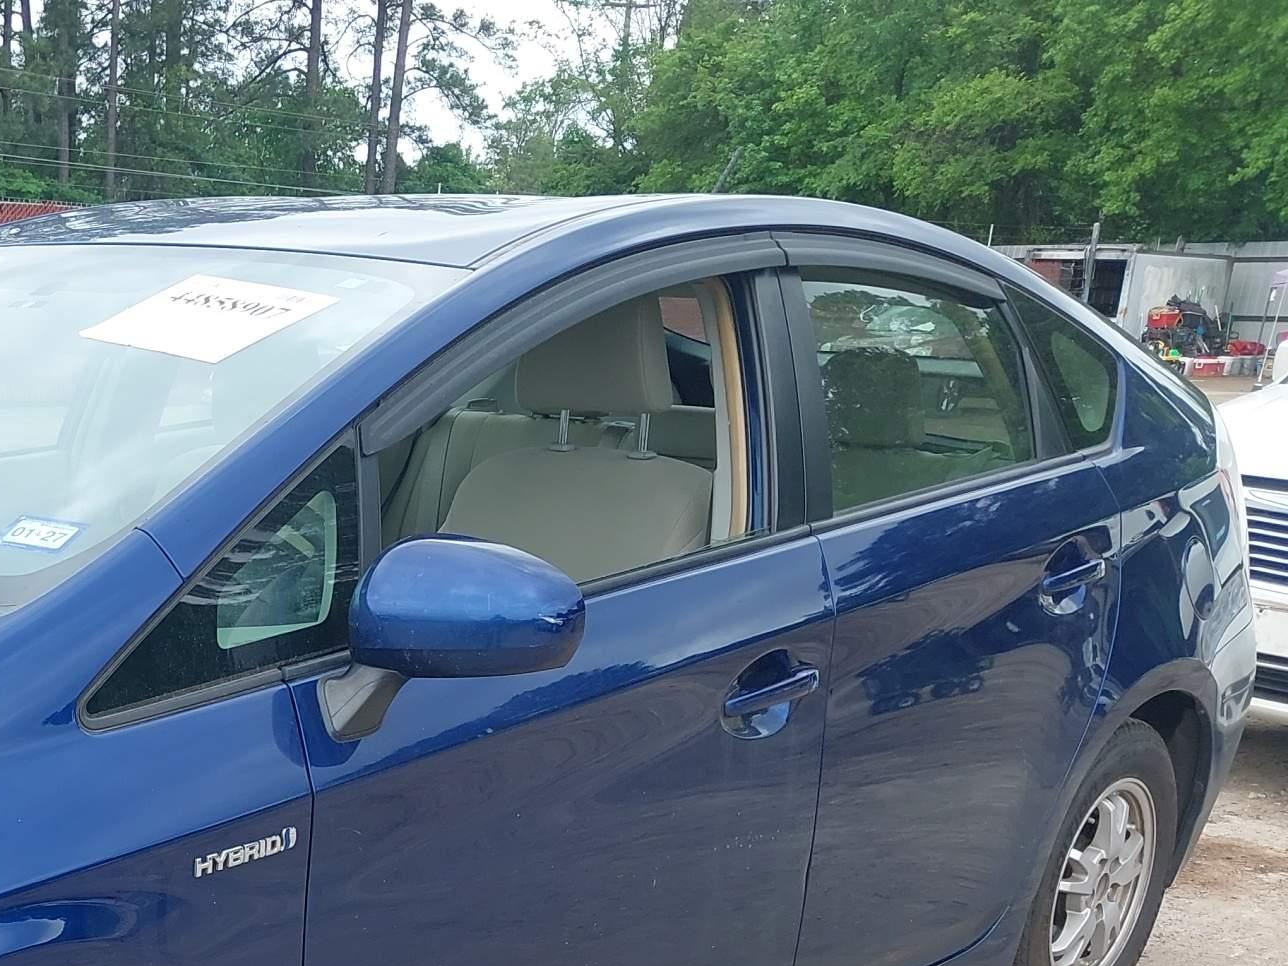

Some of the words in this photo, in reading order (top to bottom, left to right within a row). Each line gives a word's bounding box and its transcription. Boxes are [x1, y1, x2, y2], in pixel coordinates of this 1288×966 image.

[11, 527, 36, 538] 01
[40, 530, 69, 543] 27
[193, 834, 282, 878] HYBRID
